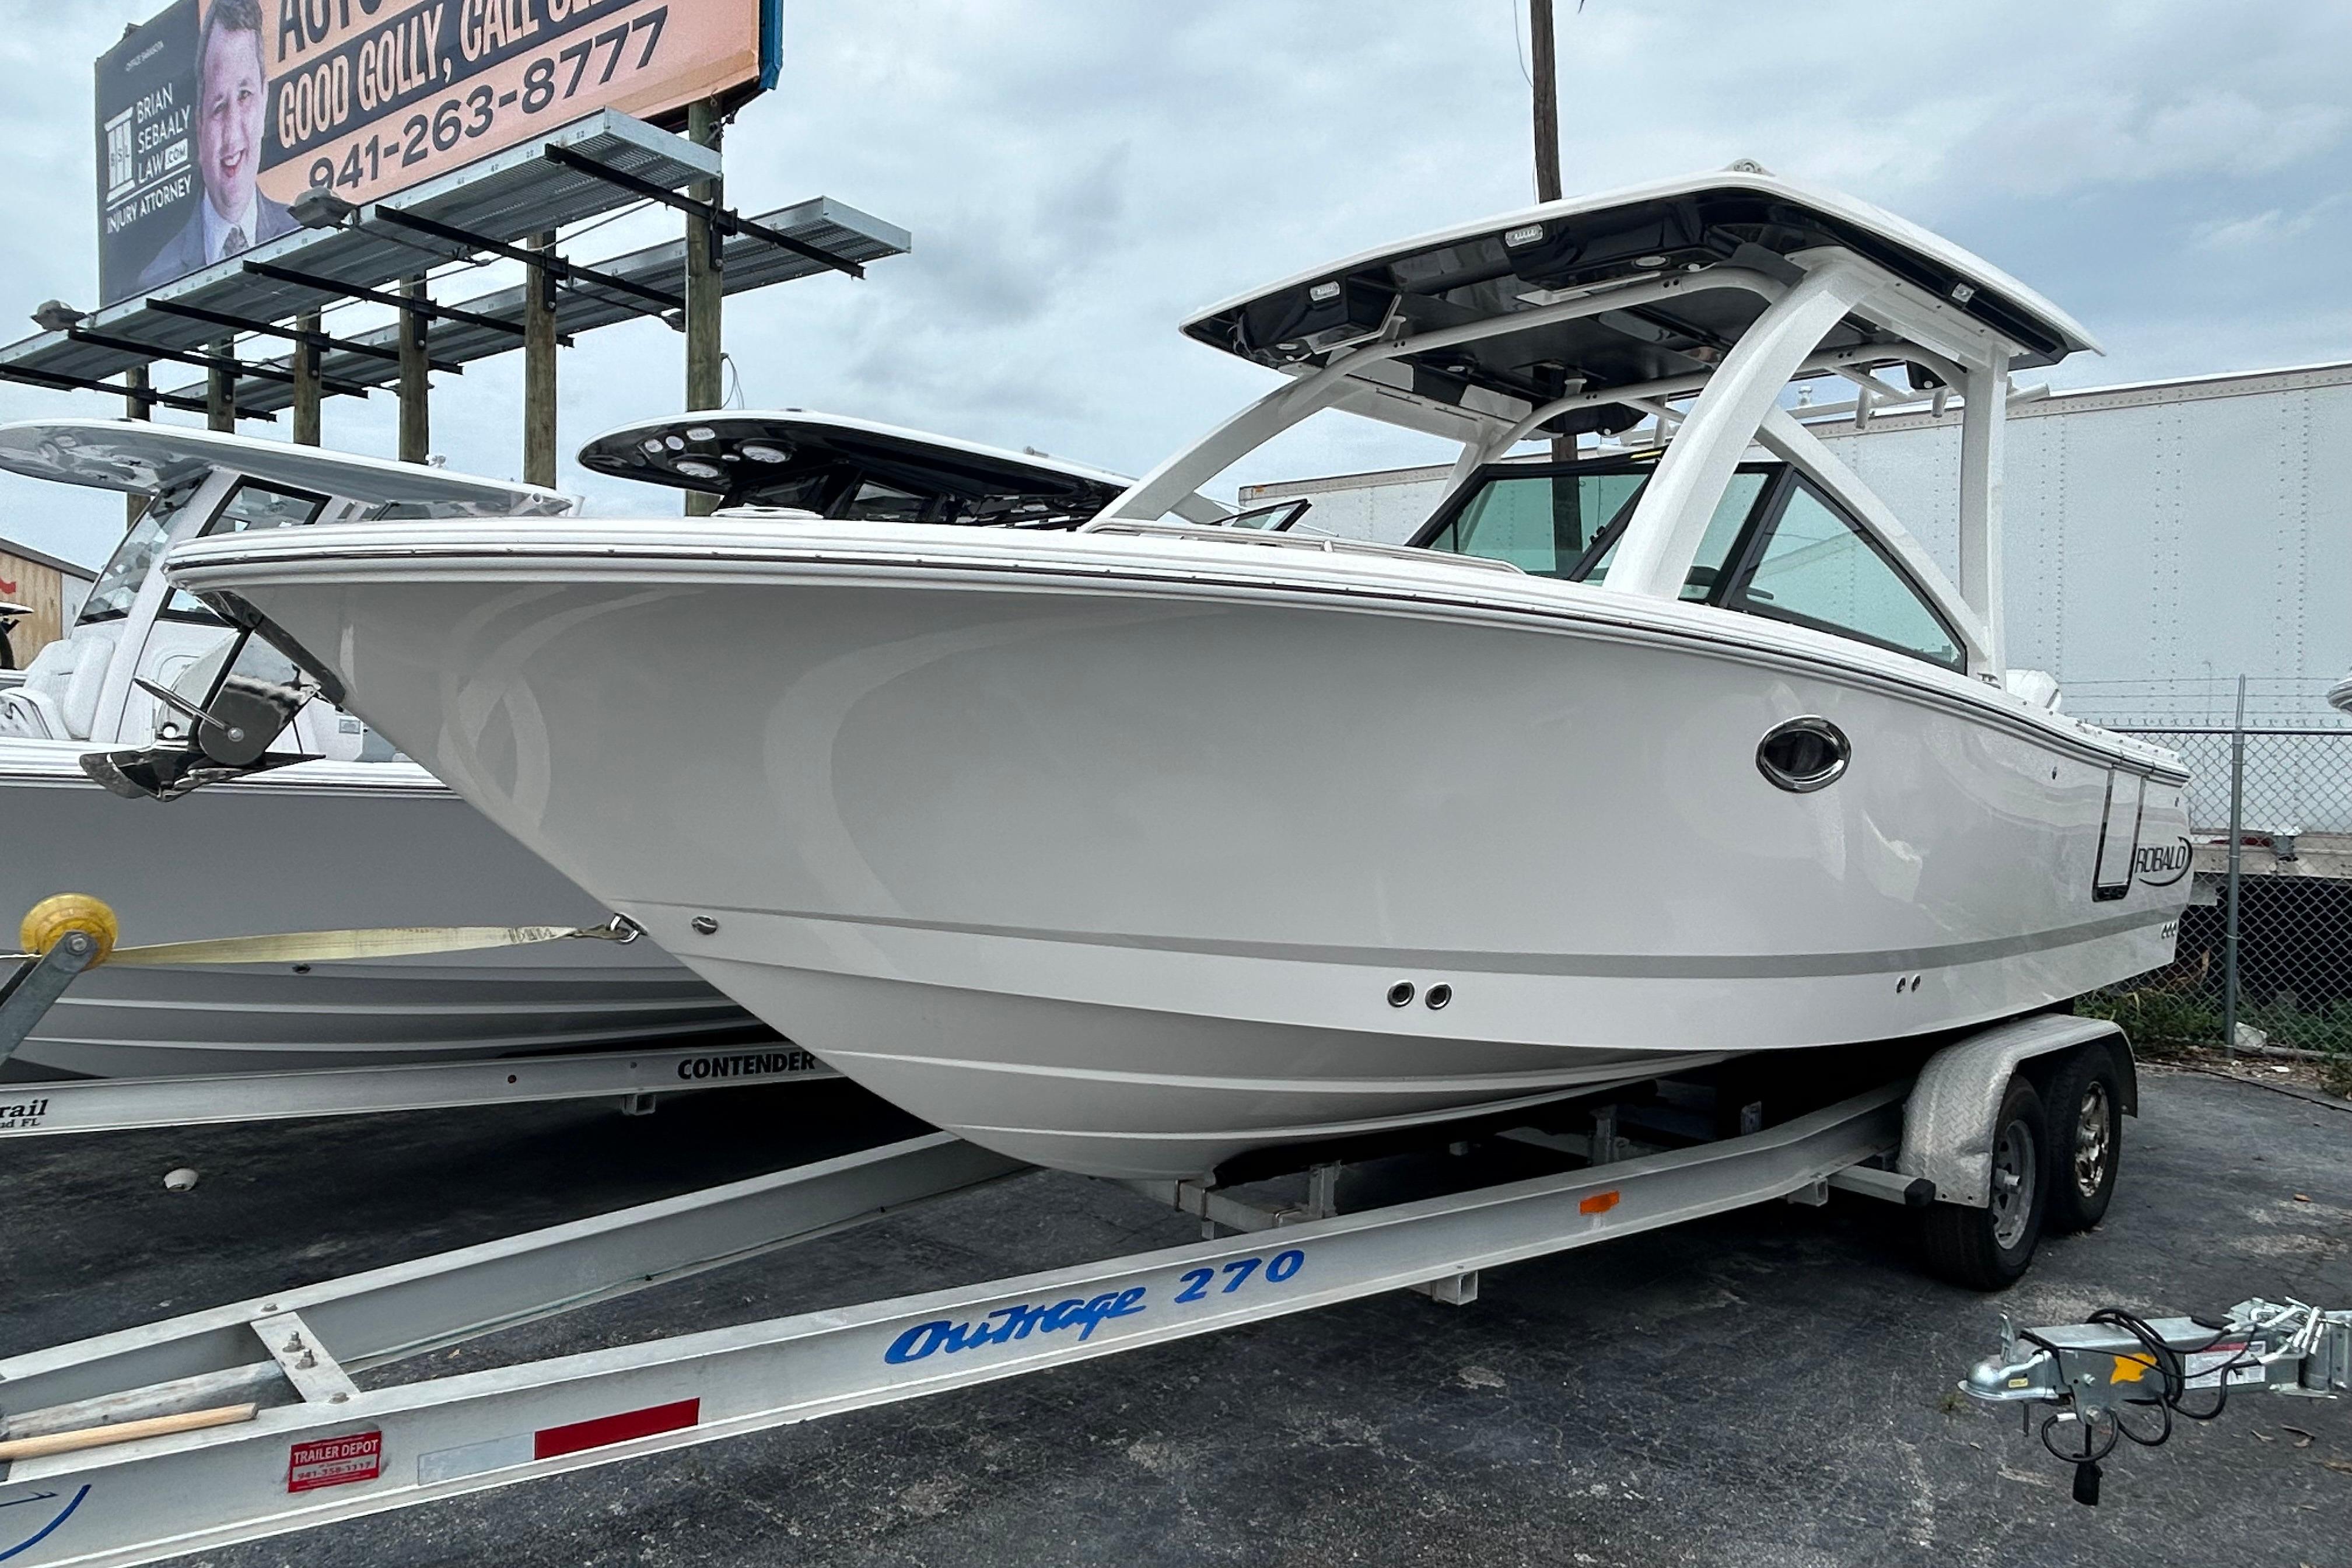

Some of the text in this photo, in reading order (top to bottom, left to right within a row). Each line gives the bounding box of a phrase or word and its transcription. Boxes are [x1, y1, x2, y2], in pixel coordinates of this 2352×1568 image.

[279, 55, 349, 149] GOOD
[358, 3, 452, 111] GOLLY,
[309, 5, 668, 190] 941-263-8777
[136, 83, 173, 124] BRIAN
[138, 104, 191, 154] SEBAALY
[106, 174, 191, 233] INJURY ATTORNEY
[2134, 846, 2186, 874] ROBALO
[677, 1051, 816, 1079] CONTENDER
[20, 1118, 41, 1127] FL
[884, 1250, 1306, 1365] Outrage 270
[293, 1446, 340, 1465] TRAILER
[342, 1438, 379, 1457] DEPOT
